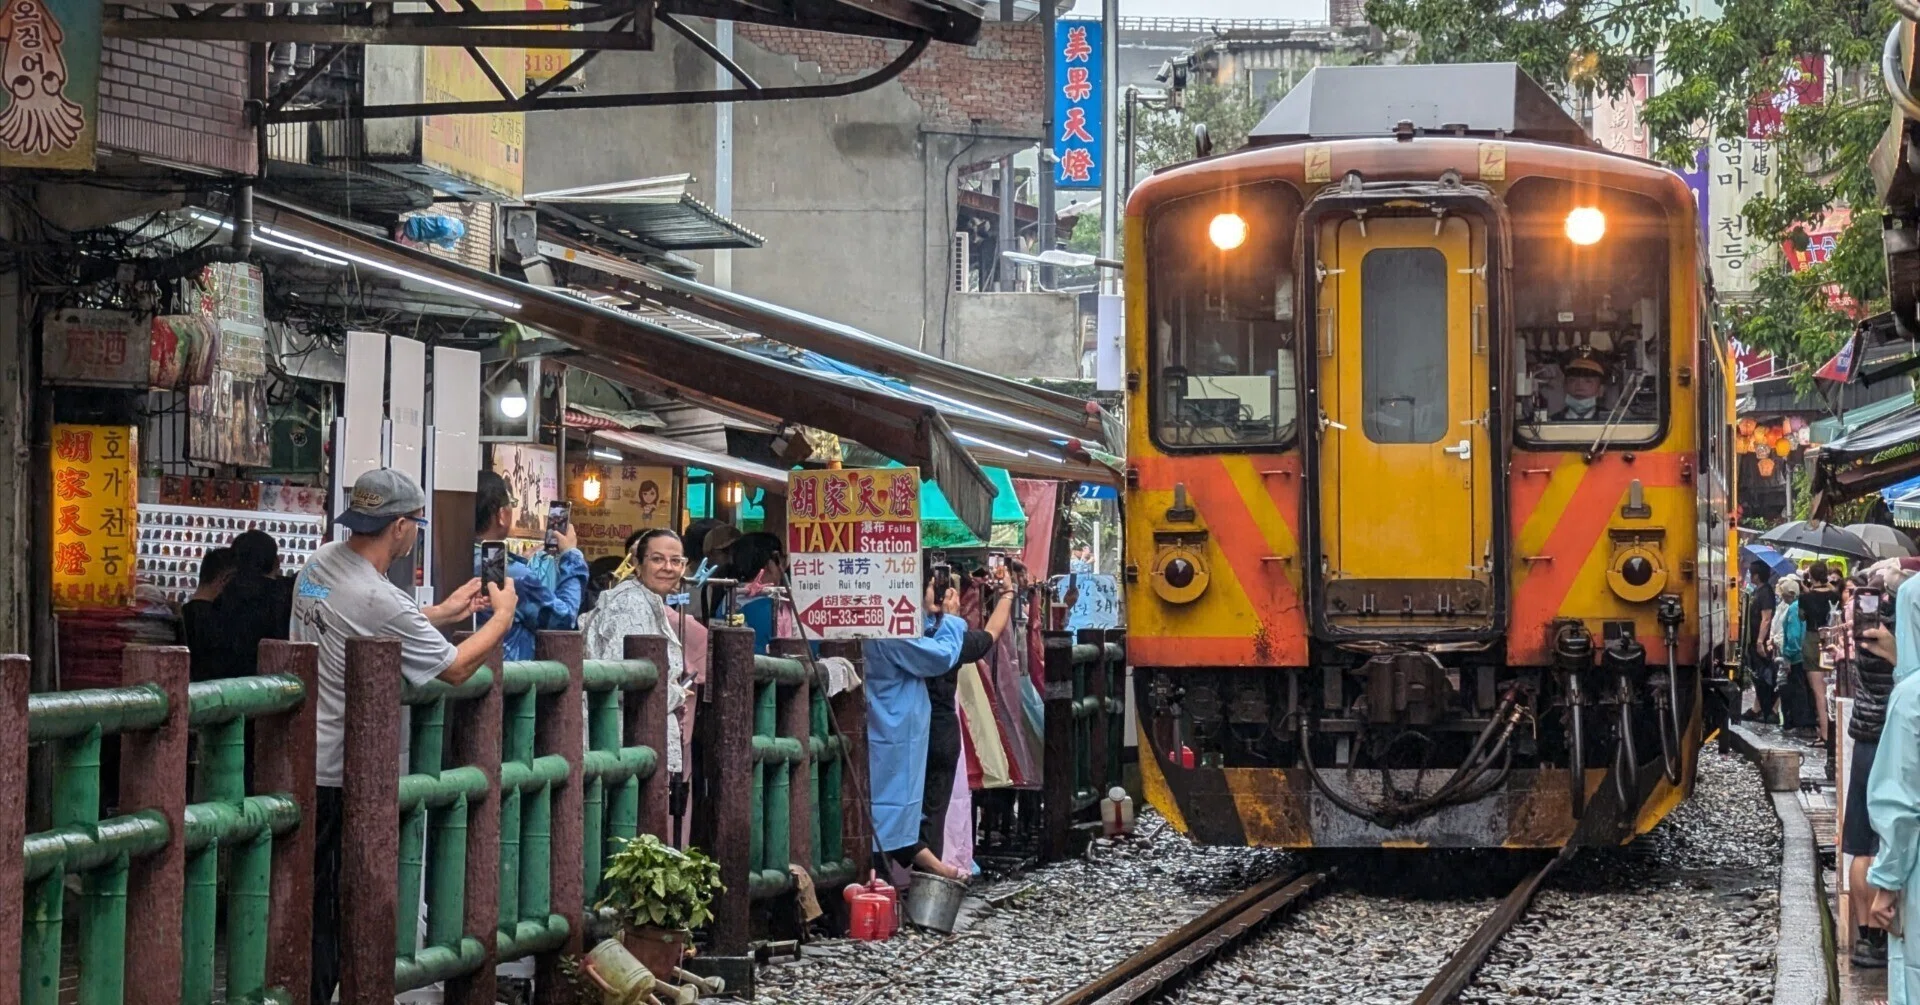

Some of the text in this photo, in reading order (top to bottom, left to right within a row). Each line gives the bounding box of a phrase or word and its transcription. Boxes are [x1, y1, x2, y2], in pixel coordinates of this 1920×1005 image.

[13, 1, 45, 75] 오징어
[1062, 26, 1095, 181] 美果天燈
[1716, 138, 1748, 270] 엄마 천등
[55, 429, 93, 576] 胡家天燈
[791, 473, 917, 519] 胡家天燈
[795, 522, 854, 553] TAXI
[860, 536, 912, 553] Station
[861, 521, 912, 533] 瀑布 Falls
[798, 580, 914, 591] Taipei Rui fang Jiufen
[824, 595, 883, 607] 胡家天燈
[807, 609, 885, 625] 0981-333-568
[887, 595, 917, 636] 洽
